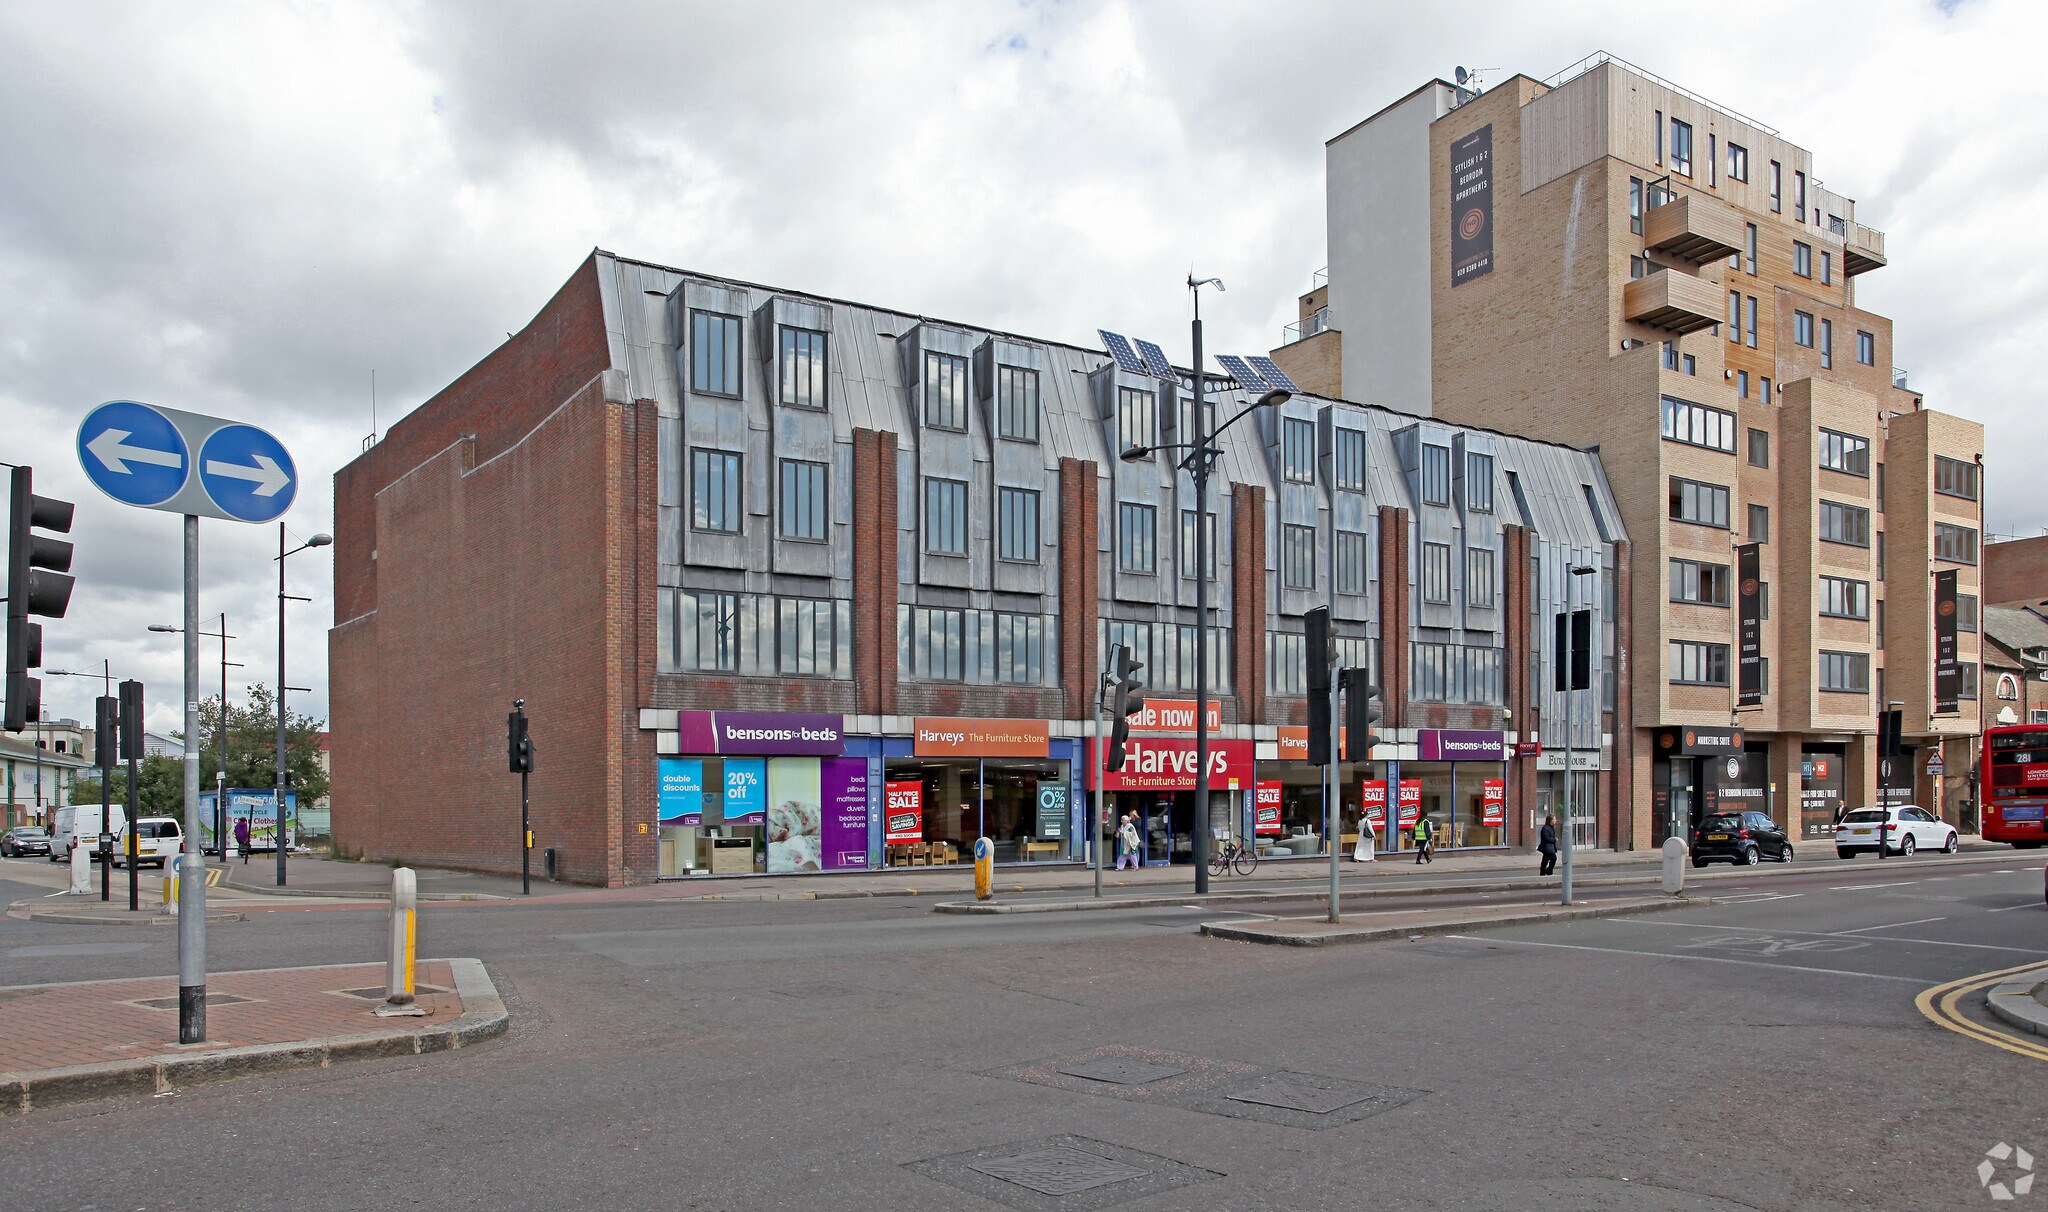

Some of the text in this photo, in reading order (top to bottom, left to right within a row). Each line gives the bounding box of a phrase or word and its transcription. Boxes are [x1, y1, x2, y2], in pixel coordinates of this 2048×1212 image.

[1454, 158, 1475, 174] STYLISH
[1484, 150, 1488, 159] 2
[1459, 167, 1484, 186] BEDROOM
[1456, 180, 1488, 202] APARTMENTS
[1161, 709, 1194, 726] now
[1206, 710, 1218, 726] n
[920, 730, 1044, 746] Harveys The Furniture Store
[1282, 736, 1308, 750] Harvey
[1698, 736, 1730, 745] MARKETING SUITE
[2016, 753, 2031, 763] 281
[728, 772, 757, 785] 20%
[1121, 776, 1136, 786] The
[1138, 776, 1175, 786] Furniture
[728, 786, 747, 799] off
[1258, 794, 1279, 802] SALE
[1365, 792, 1384, 801] SALE
[1400, 792, 1419, 800] SALE
[1485, 791, 1502, 799] SALE
[888, 797, 919, 808] SALE
[1041, 790, 1065, 808] 0%
[892, 821, 914, 830] SAVINGS
